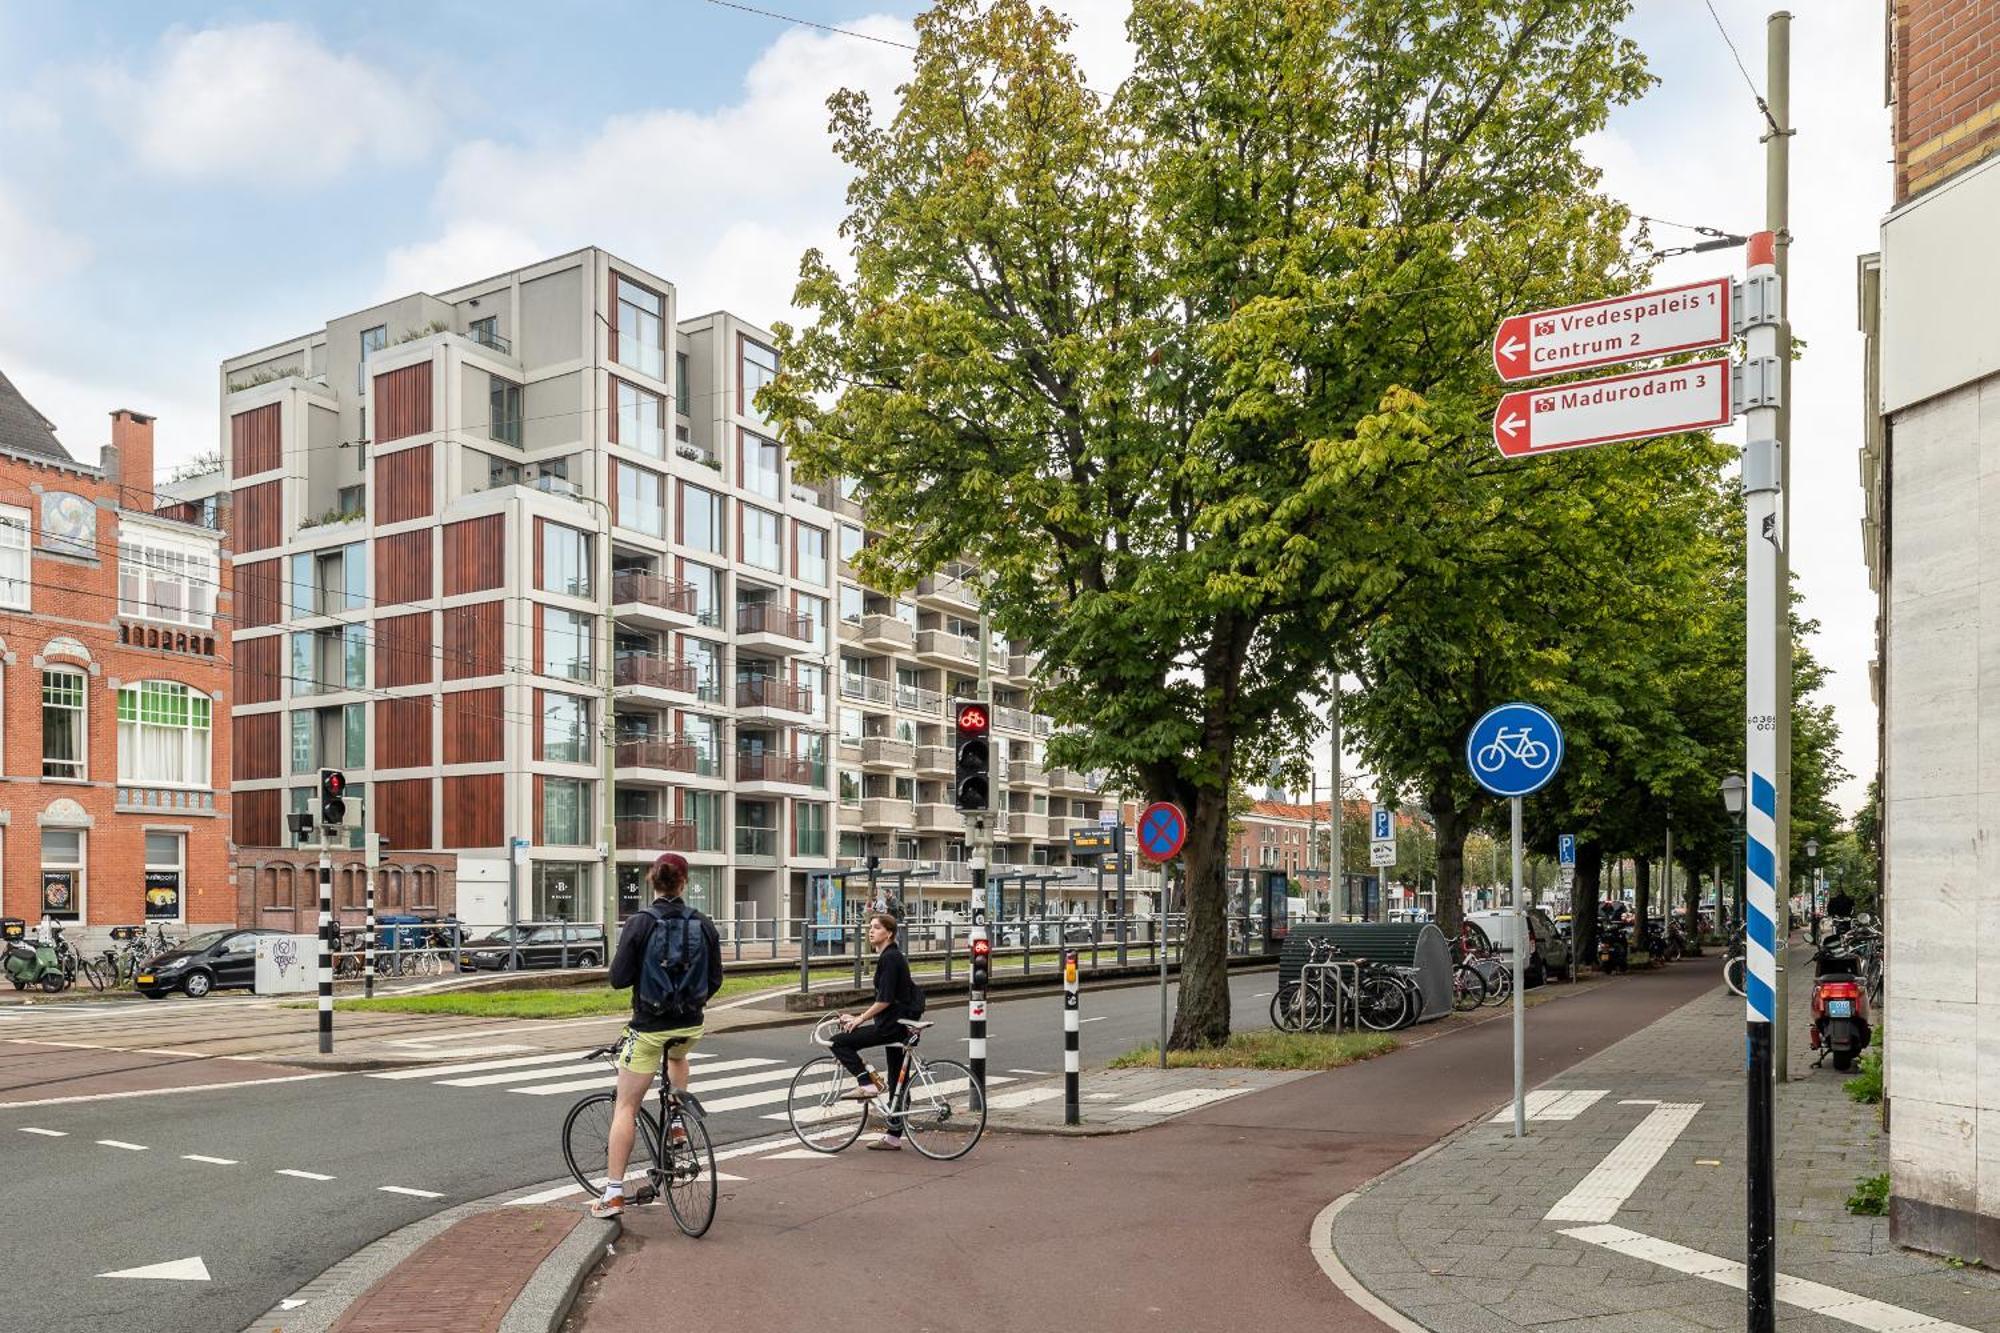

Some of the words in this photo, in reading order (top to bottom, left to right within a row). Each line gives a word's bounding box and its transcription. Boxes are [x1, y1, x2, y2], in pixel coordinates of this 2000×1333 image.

[1561, 294, 1700, 331] Vredespaleis
[1707, 291, 1716, 306] 1
[1534, 336, 1622, 363] Centrum
[1630, 332, 1641, 347] 2
[1561, 378, 1688, 410] Madurodam
[1695, 374, 1706, 389] 3
